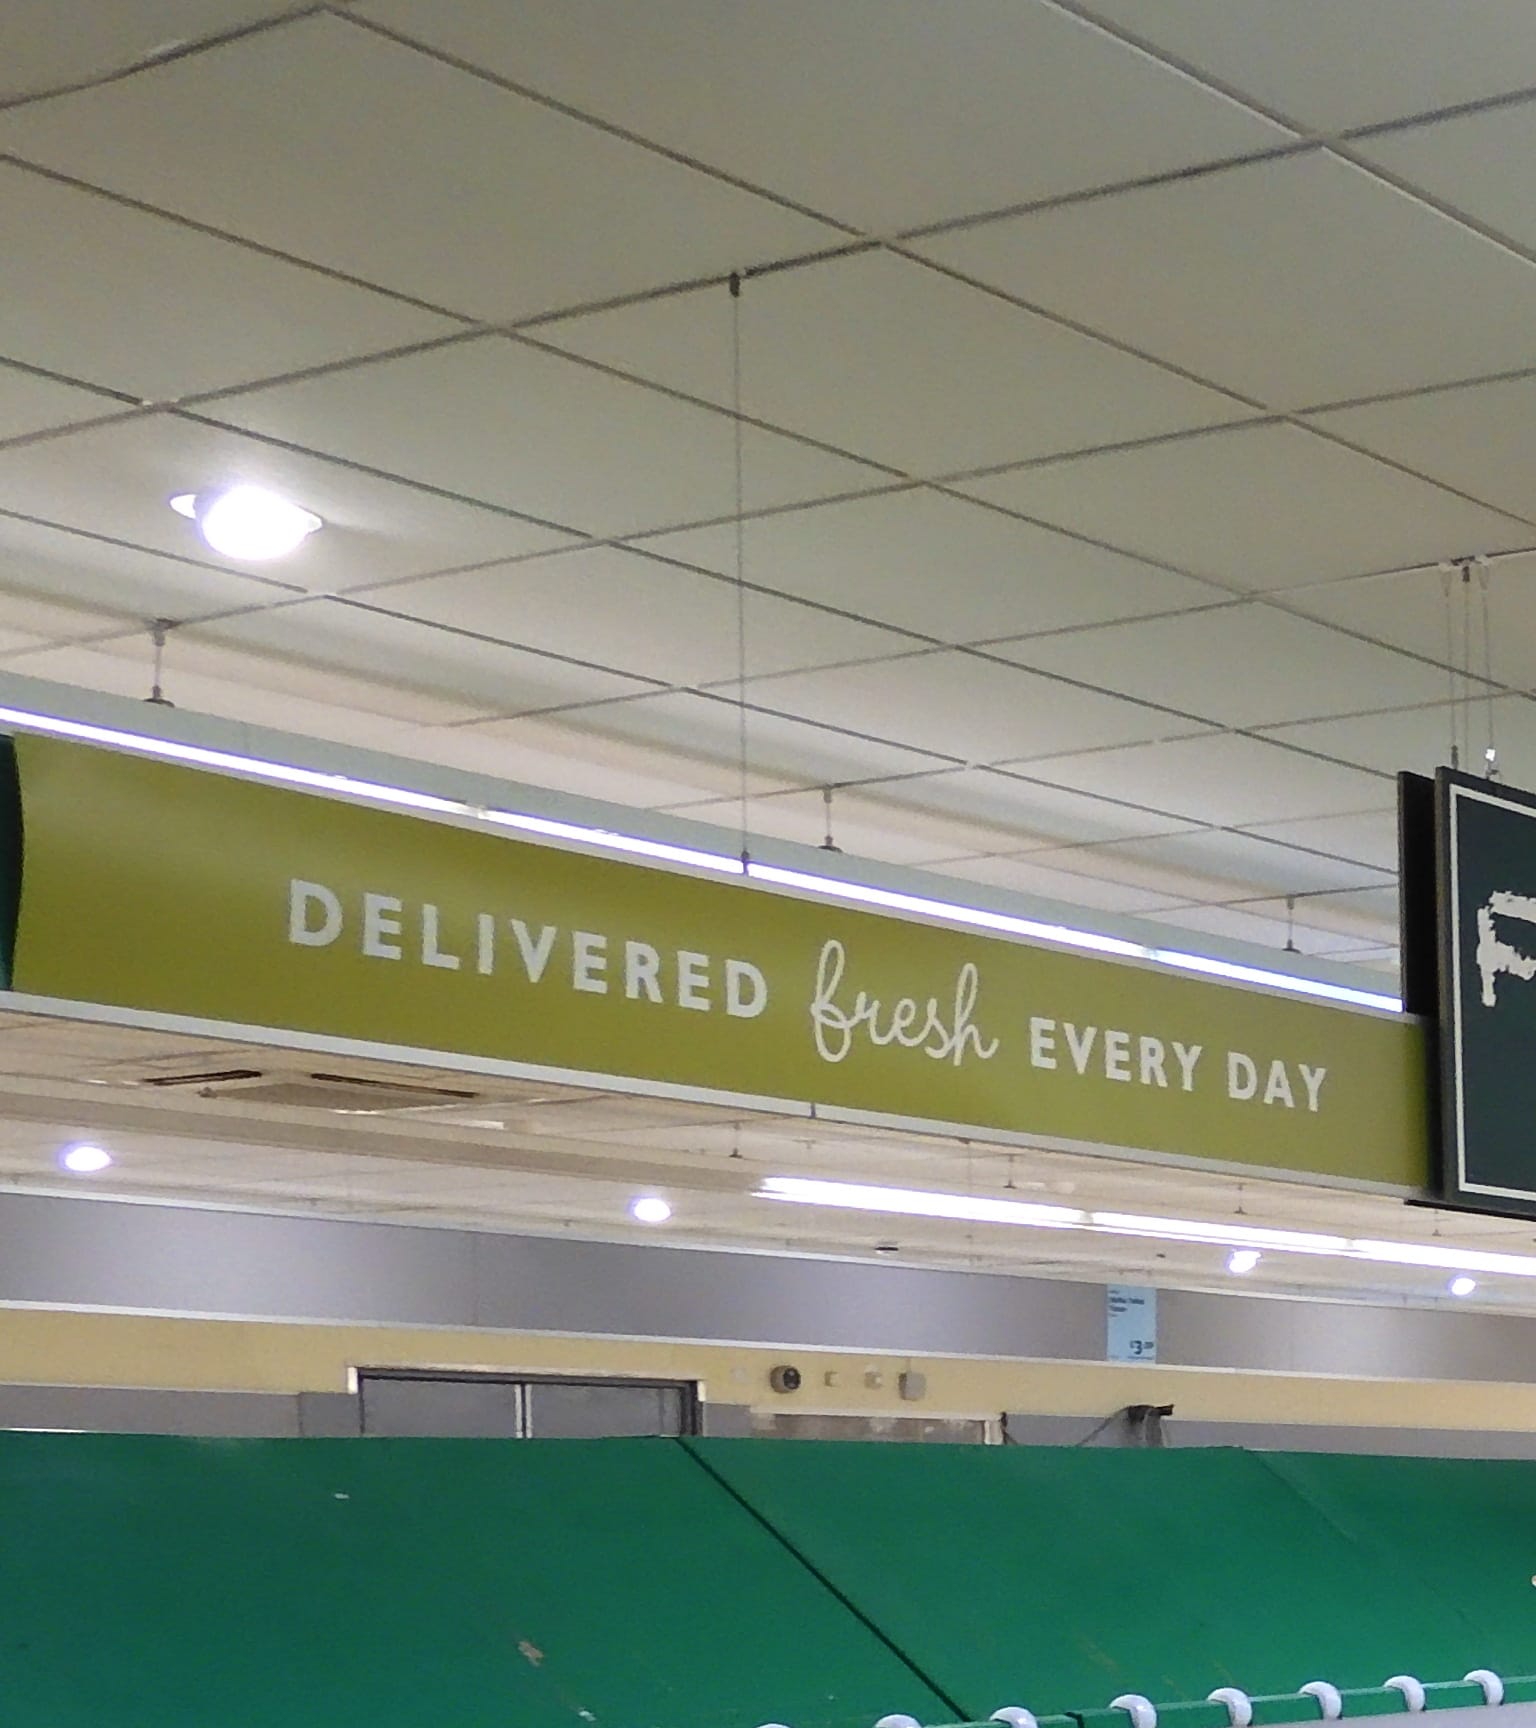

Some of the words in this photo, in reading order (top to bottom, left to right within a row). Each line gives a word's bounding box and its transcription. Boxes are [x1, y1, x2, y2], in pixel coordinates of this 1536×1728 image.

[290, 879, 769, 1018] DELIVERED
[809, 939, 999, 1066] fresh
[1029, 1016, 1203, 1092] EVERY
[1227, 1051, 1327, 1113] DAY
